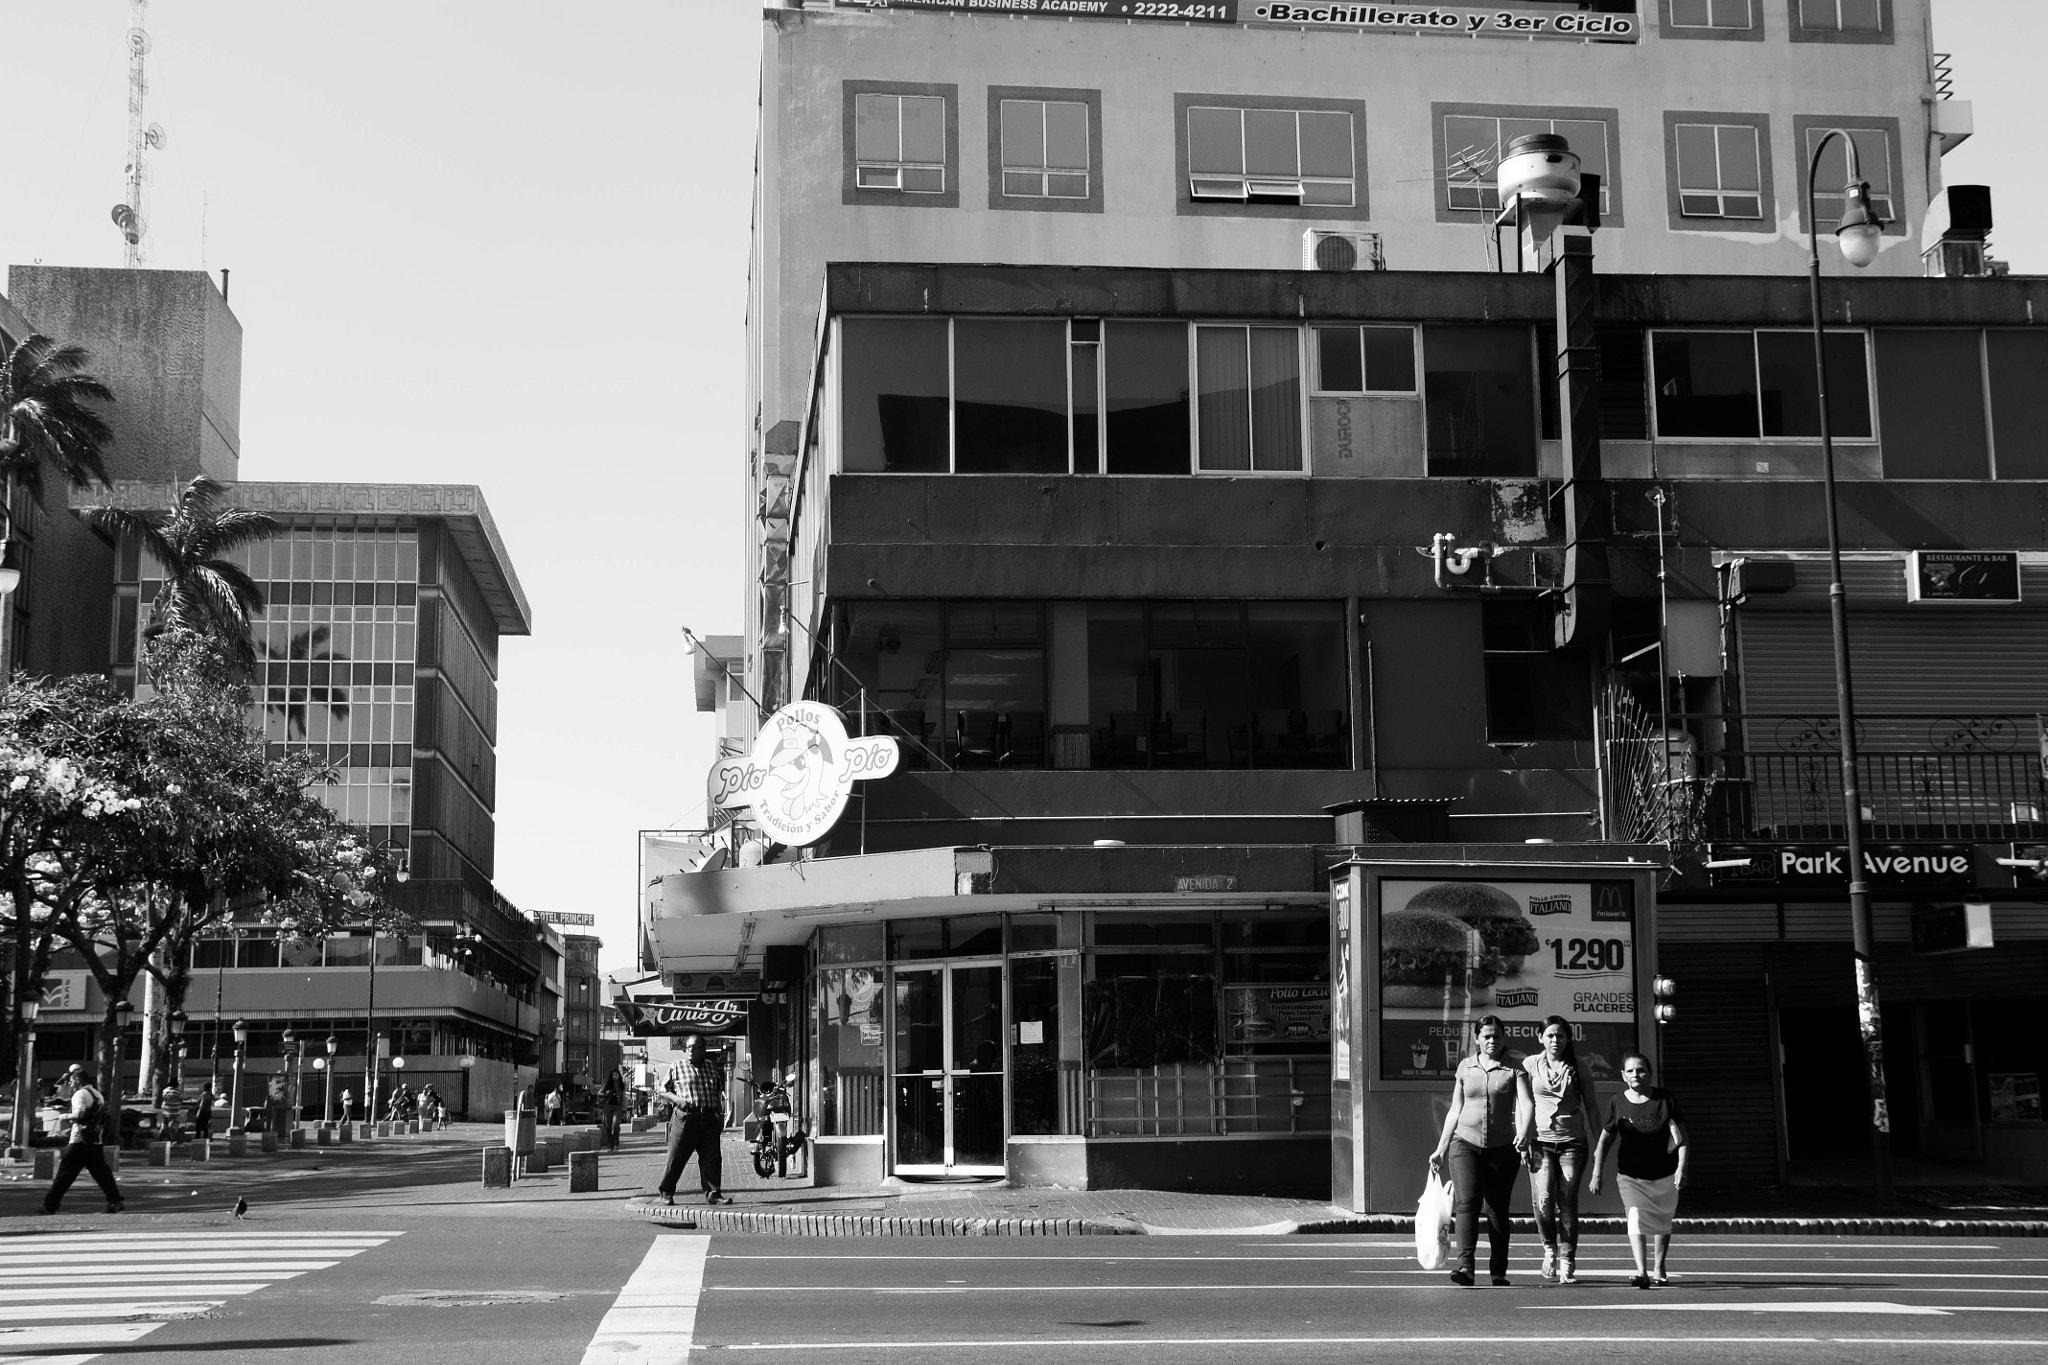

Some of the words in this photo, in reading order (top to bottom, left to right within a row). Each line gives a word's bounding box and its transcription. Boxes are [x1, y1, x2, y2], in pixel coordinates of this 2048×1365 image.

[968, 0, 1038, 10] BUSINESS
[1041, 0, 1108, 13] ACADEMY
[1134, 2, 1227, 19] 2222-4211
[1269, 4, 1458, 26] Bachillerato
[1467, 15, 1486, 31] y
[1495, 12, 1546, 30] 3er
[1554, 14, 1632, 34] Ciclo
[1926, 554, 1981, 562] RESTAURANTE
[1983, 554, 1990, 562] &
[1991, 554, 2009, 562] BAR
[775, 708, 822, 732] Pollos
[759, 799, 804, 834] Tradición
[805, 820, 813, 833] y
[814, 789, 840, 825] Sabor
[1781, 851, 1844, 874] Park
[1863, 851, 1970, 874] Avenue
[1177, 877, 1219, 890] AVENIDA
[1226, 877, 1233, 890] 2
[1530, 901, 1571, 914] ITALIANO
[535, 911, 559, 923] OTEL
[560, 913, 593, 925] PRINCIPE
[1270, 987, 1300, 998] Pollo
[1573, 992, 1634, 1003] GRANDES
[1496, 993, 1537, 1006] ITALIANO
[657, 1000, 711, 1024] Carl's
[1573, 1003, 1634, 1013] PLACERES
